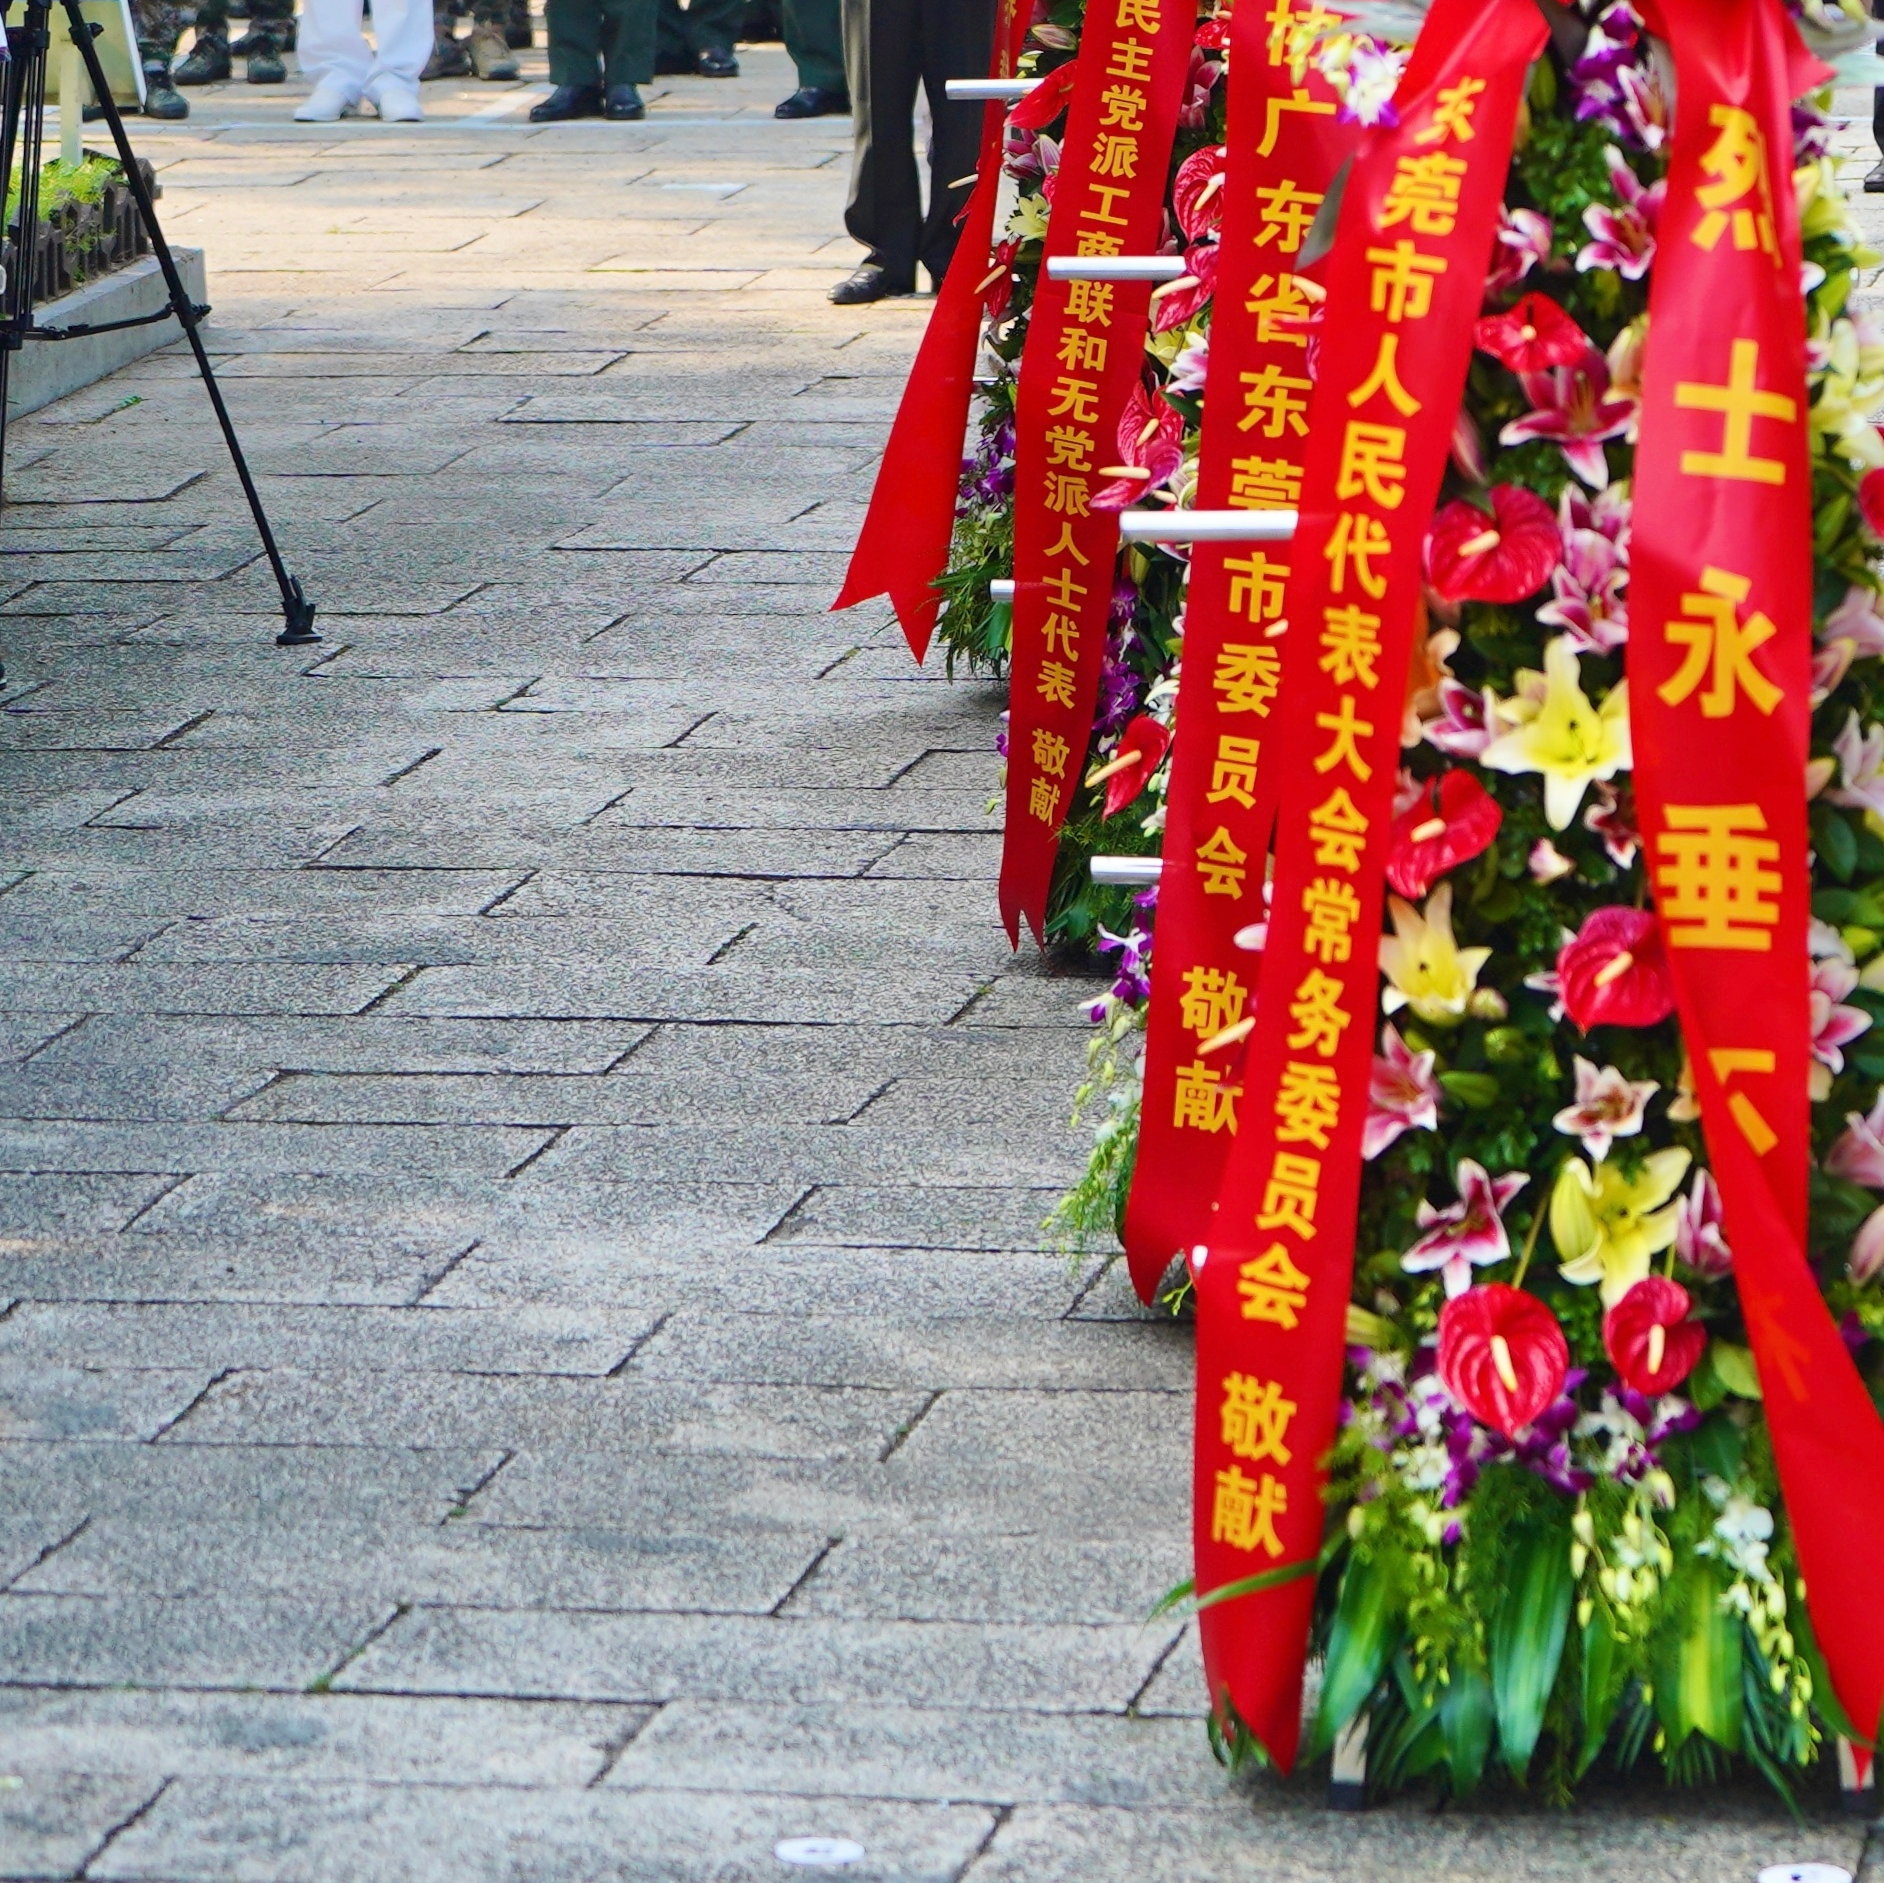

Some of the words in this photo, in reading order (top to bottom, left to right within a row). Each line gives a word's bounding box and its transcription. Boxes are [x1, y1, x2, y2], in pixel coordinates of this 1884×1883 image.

[1236, 76, 1486, 1329] 东莞市人民代表大会常务委员会
[1657, 105, 1798, 1155] 烈士永垂
[1029, 728, 1071, 826] 敬献
[1173, 964, 1248, 1136] 敬献
[1212, 1372, 1298, 1558] 敬献
